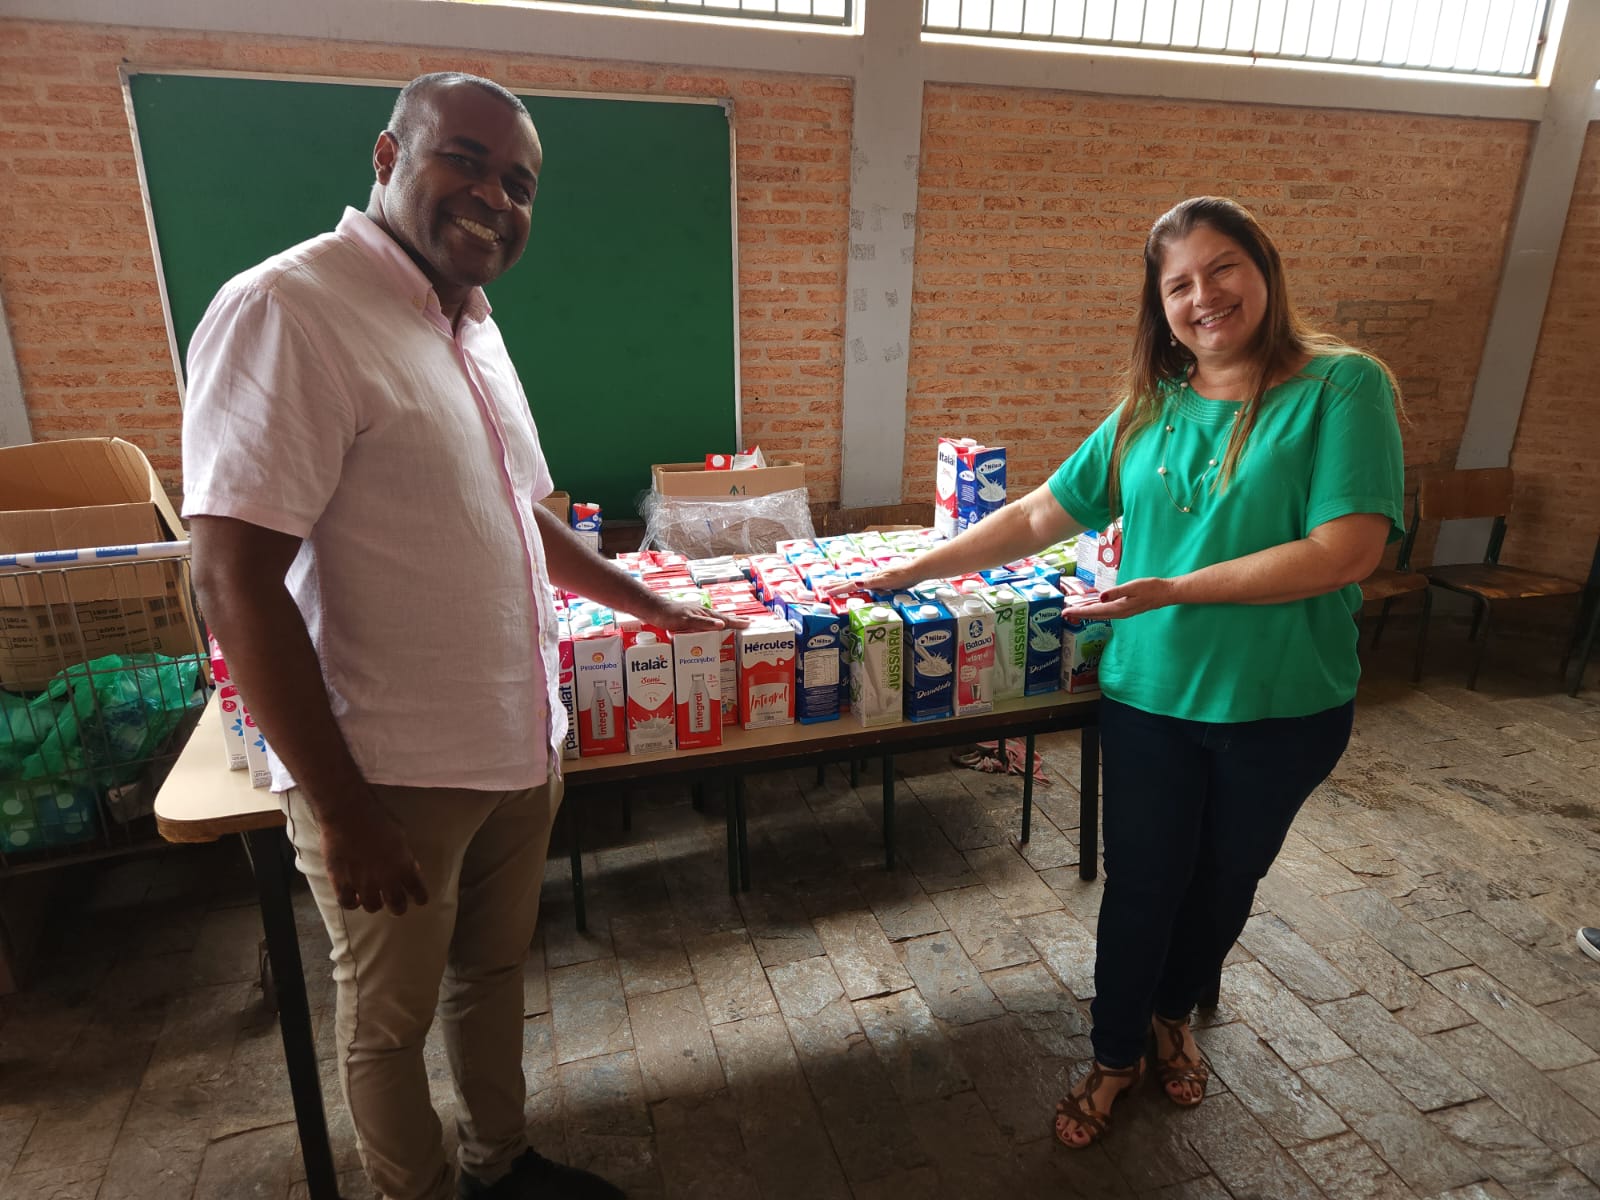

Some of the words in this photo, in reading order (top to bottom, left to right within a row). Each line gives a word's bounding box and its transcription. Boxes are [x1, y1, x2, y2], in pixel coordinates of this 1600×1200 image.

[744, 639, 794, 654] Hércules
[965, 636, 993, 650] Batavo
[1014, 607, 1027, 668] JUSSARA
[631, 657, 668, 673] Italac
[888, 627, 901, 691] JUSSARA
[695, 691, 705, 729] integral
[750, 685, 788, 713] Integral
[597, 698, 608, 735] integral
